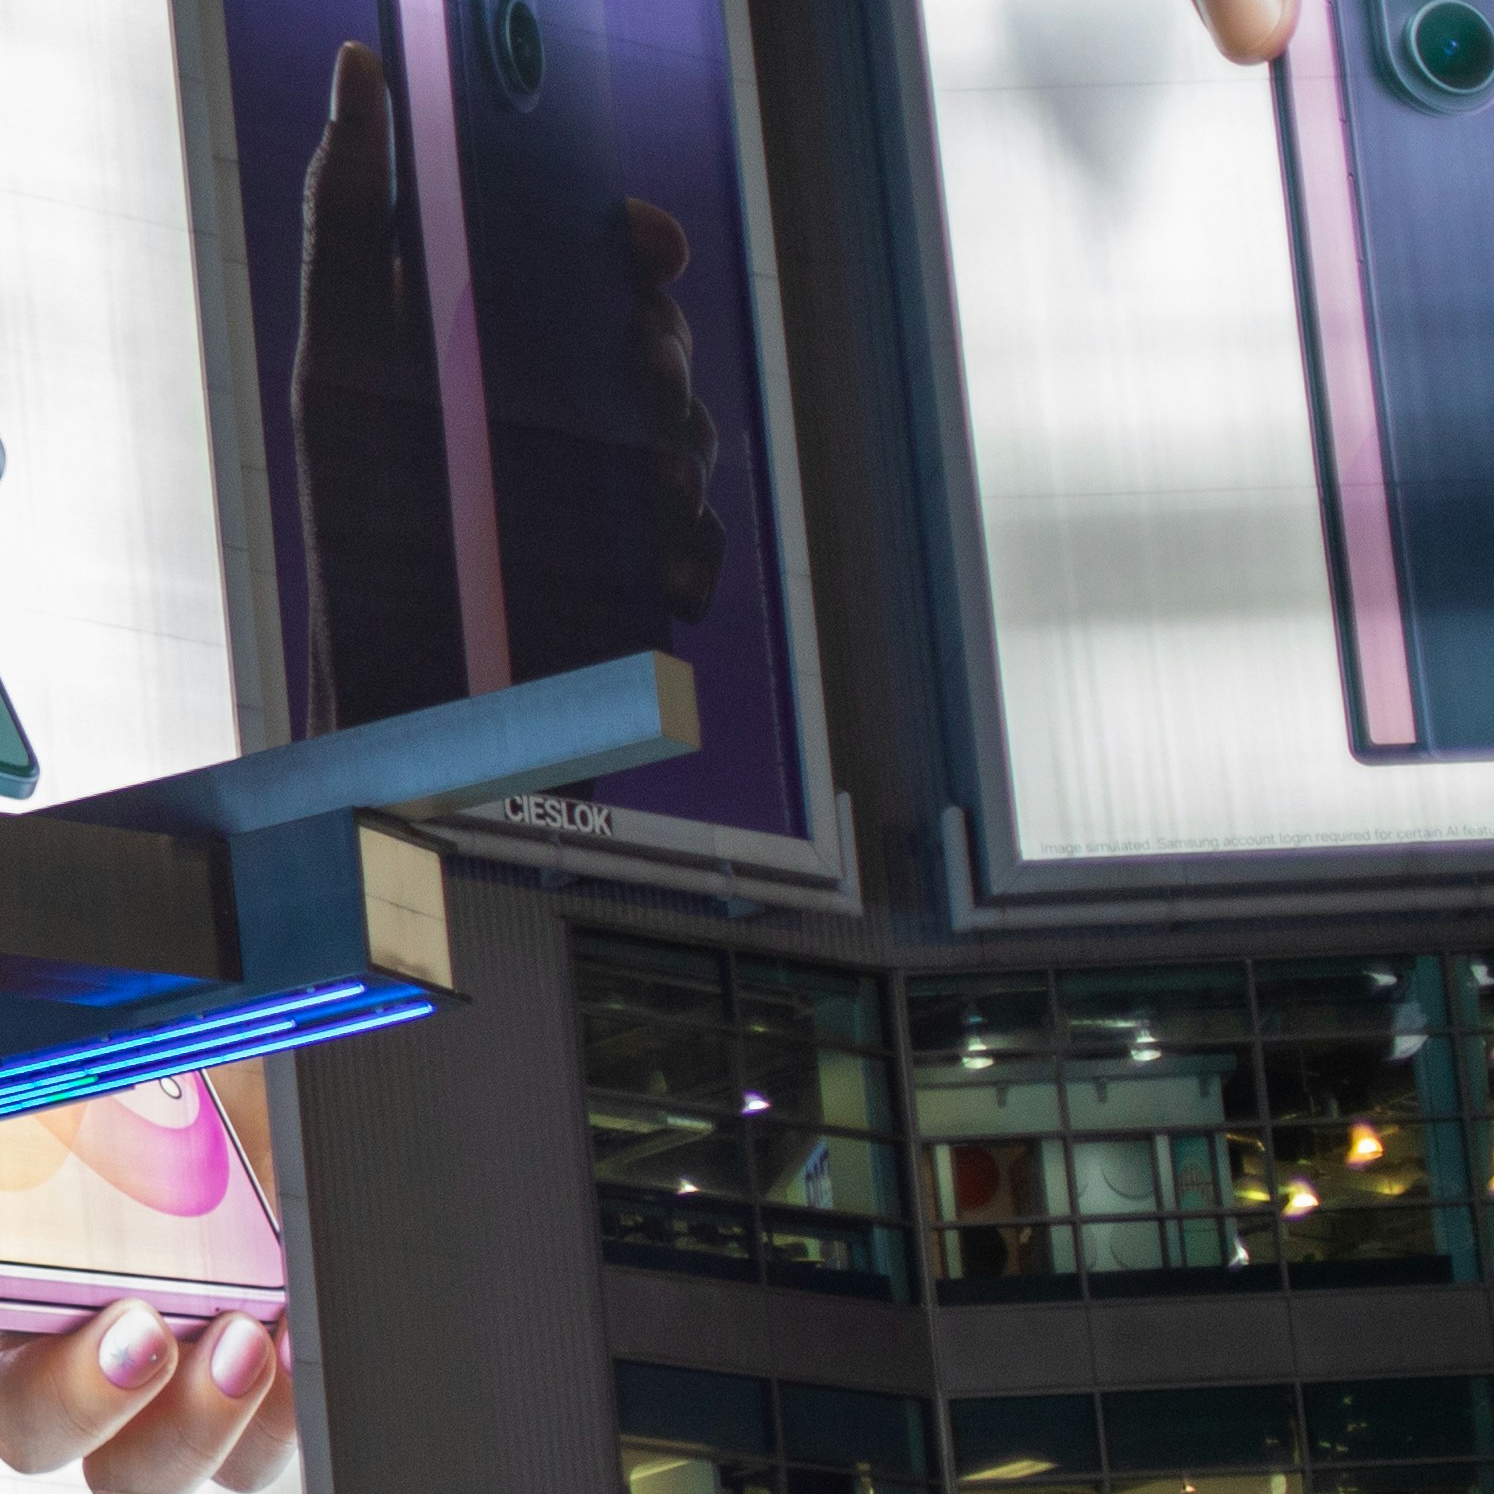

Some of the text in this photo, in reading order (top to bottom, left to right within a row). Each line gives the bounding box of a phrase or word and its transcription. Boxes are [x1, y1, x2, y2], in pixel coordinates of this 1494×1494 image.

[504, 795, 613, 837] CIESLOK
[1222, 832, 1277, 848] account
[1278, 830, 1313, 848] login
[1314, 826, 1371, 845] required
[1374, 826, 1393, 841] for
